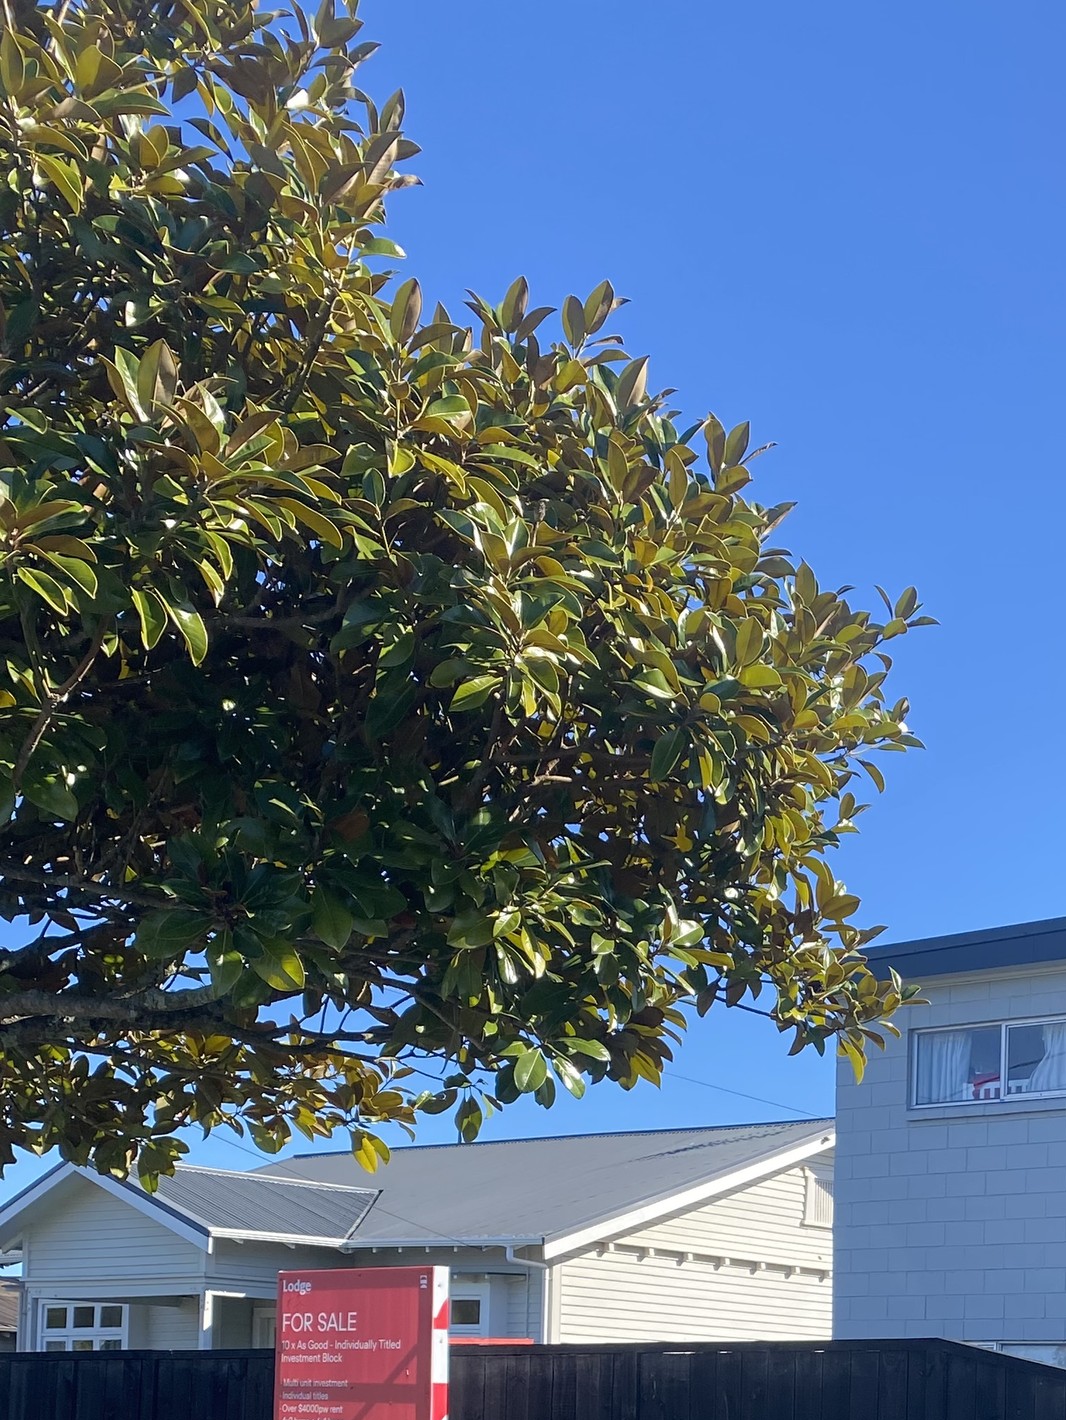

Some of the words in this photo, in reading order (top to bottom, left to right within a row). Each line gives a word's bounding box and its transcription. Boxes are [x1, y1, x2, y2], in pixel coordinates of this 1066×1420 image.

[283, 1280, 312, 1295] Lodge
[282, 1313, 313, 1332] FOR
[317, 1312, 357, 1332] SALE
[281, 1341, 290, 1350] 10
[297, 1341, 307, 1350] As
[307, 1340, 329, 1350] Good
[334, 1340, 377, 1352] Individually
[378, 1339, 401, 1350] Titled
[281, 1353, 320, 1363] Investment
[322, 1353, 343, 1363] Block
[282, 1403, 297, 1413] Over
